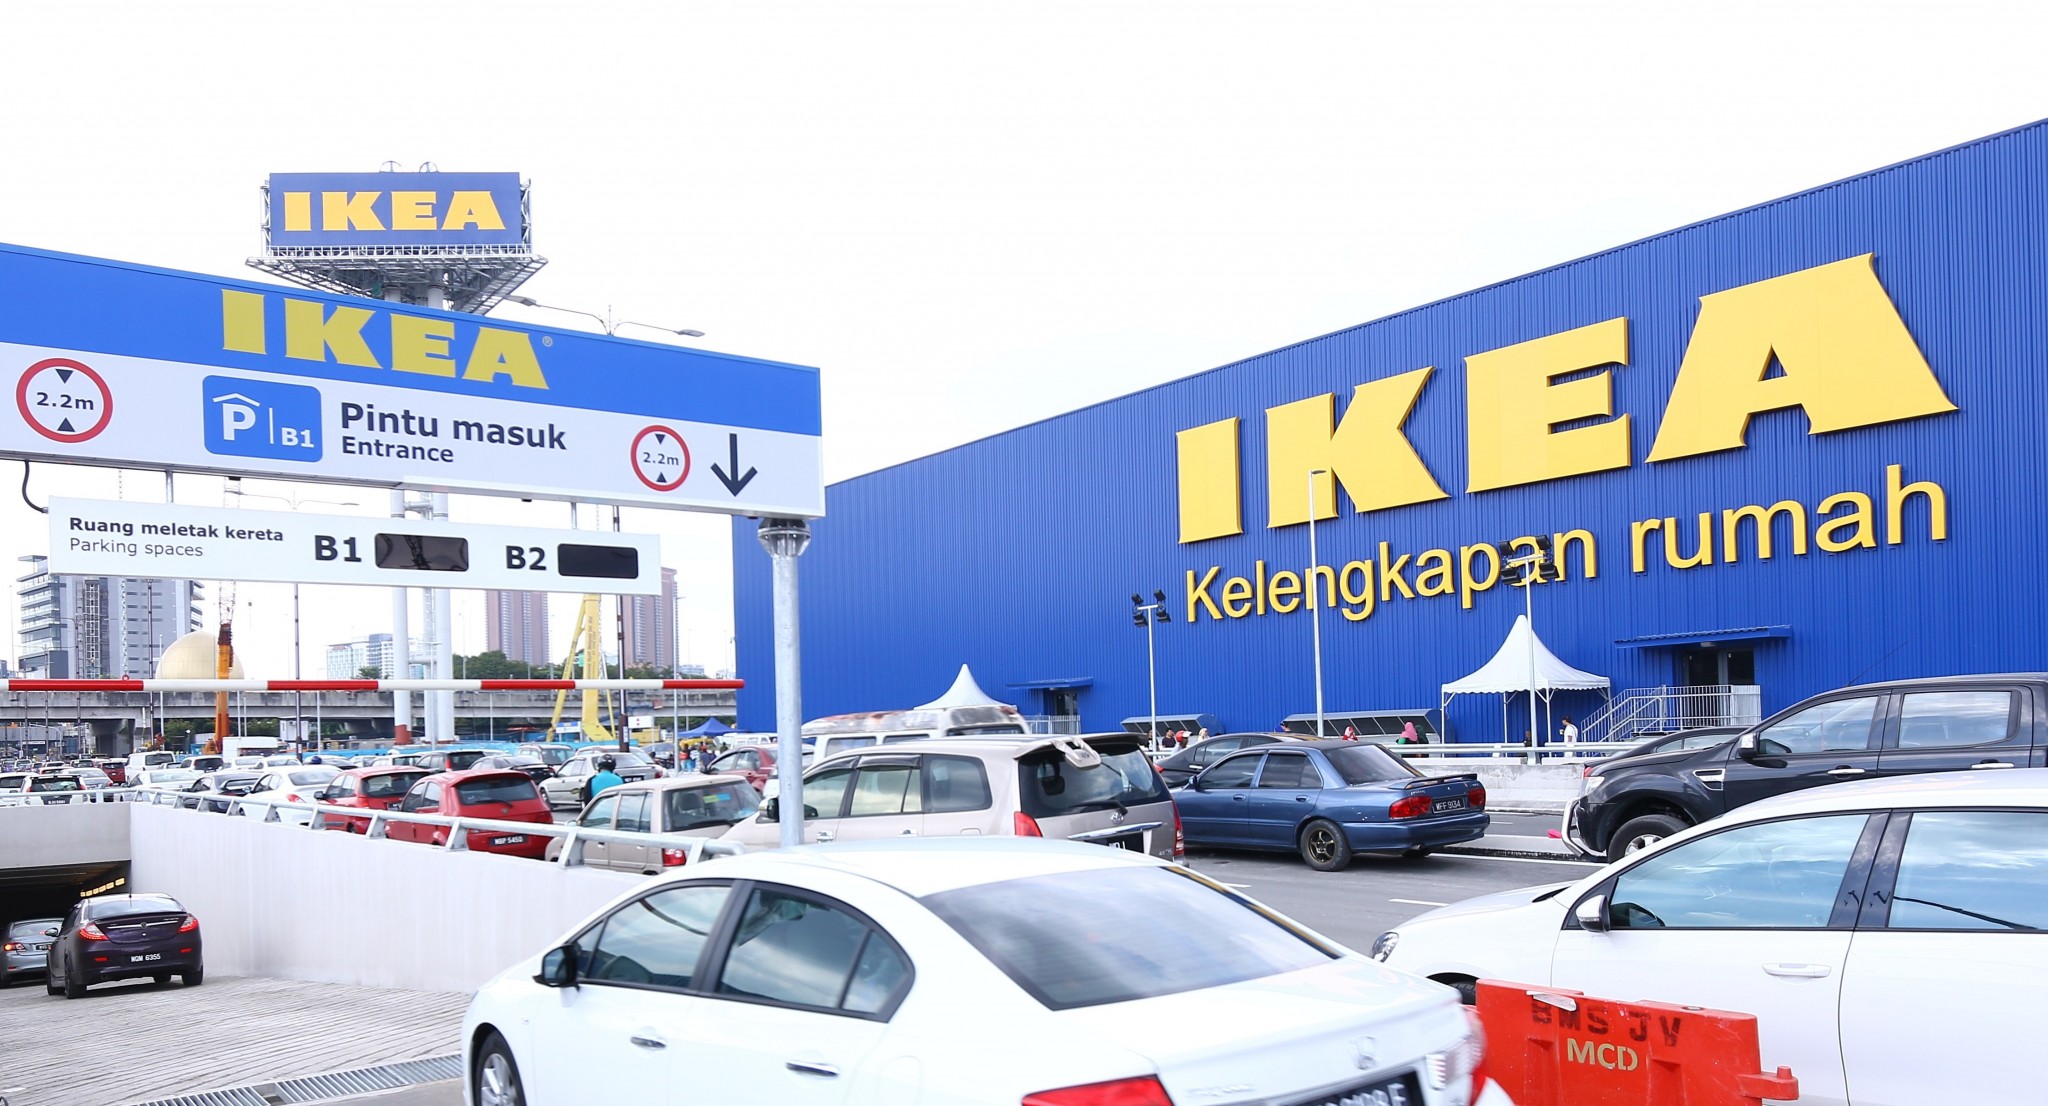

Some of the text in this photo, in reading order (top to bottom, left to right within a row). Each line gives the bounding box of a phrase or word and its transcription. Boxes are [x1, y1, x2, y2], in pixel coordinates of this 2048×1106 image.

[283, 190, 506, 231] IKEA
[221, 289, 550, 390] IKEA
[36, 391, 95, 411] 2.2m
[1177, 253, 1957, 544] IKEA
[222, 403, 257, 441] P
[340, 402, 568, 450] Pintu masuk
[280, 427, 315, 449] B1
[341, 436, 455, 463] Entrance
[642, 451, 680, 466] 2.2m
[69, 517, 284, 542] Ruang meletak kereta
[1185, 463, 1948, 623] Kelengkapan rumah
[70, 537, 204, 558] Parking spaces
[314, 535, 362, 563] B1
[506, 545, 548, 571] B2
[1567, 1037, 1639, 1071] MCD
